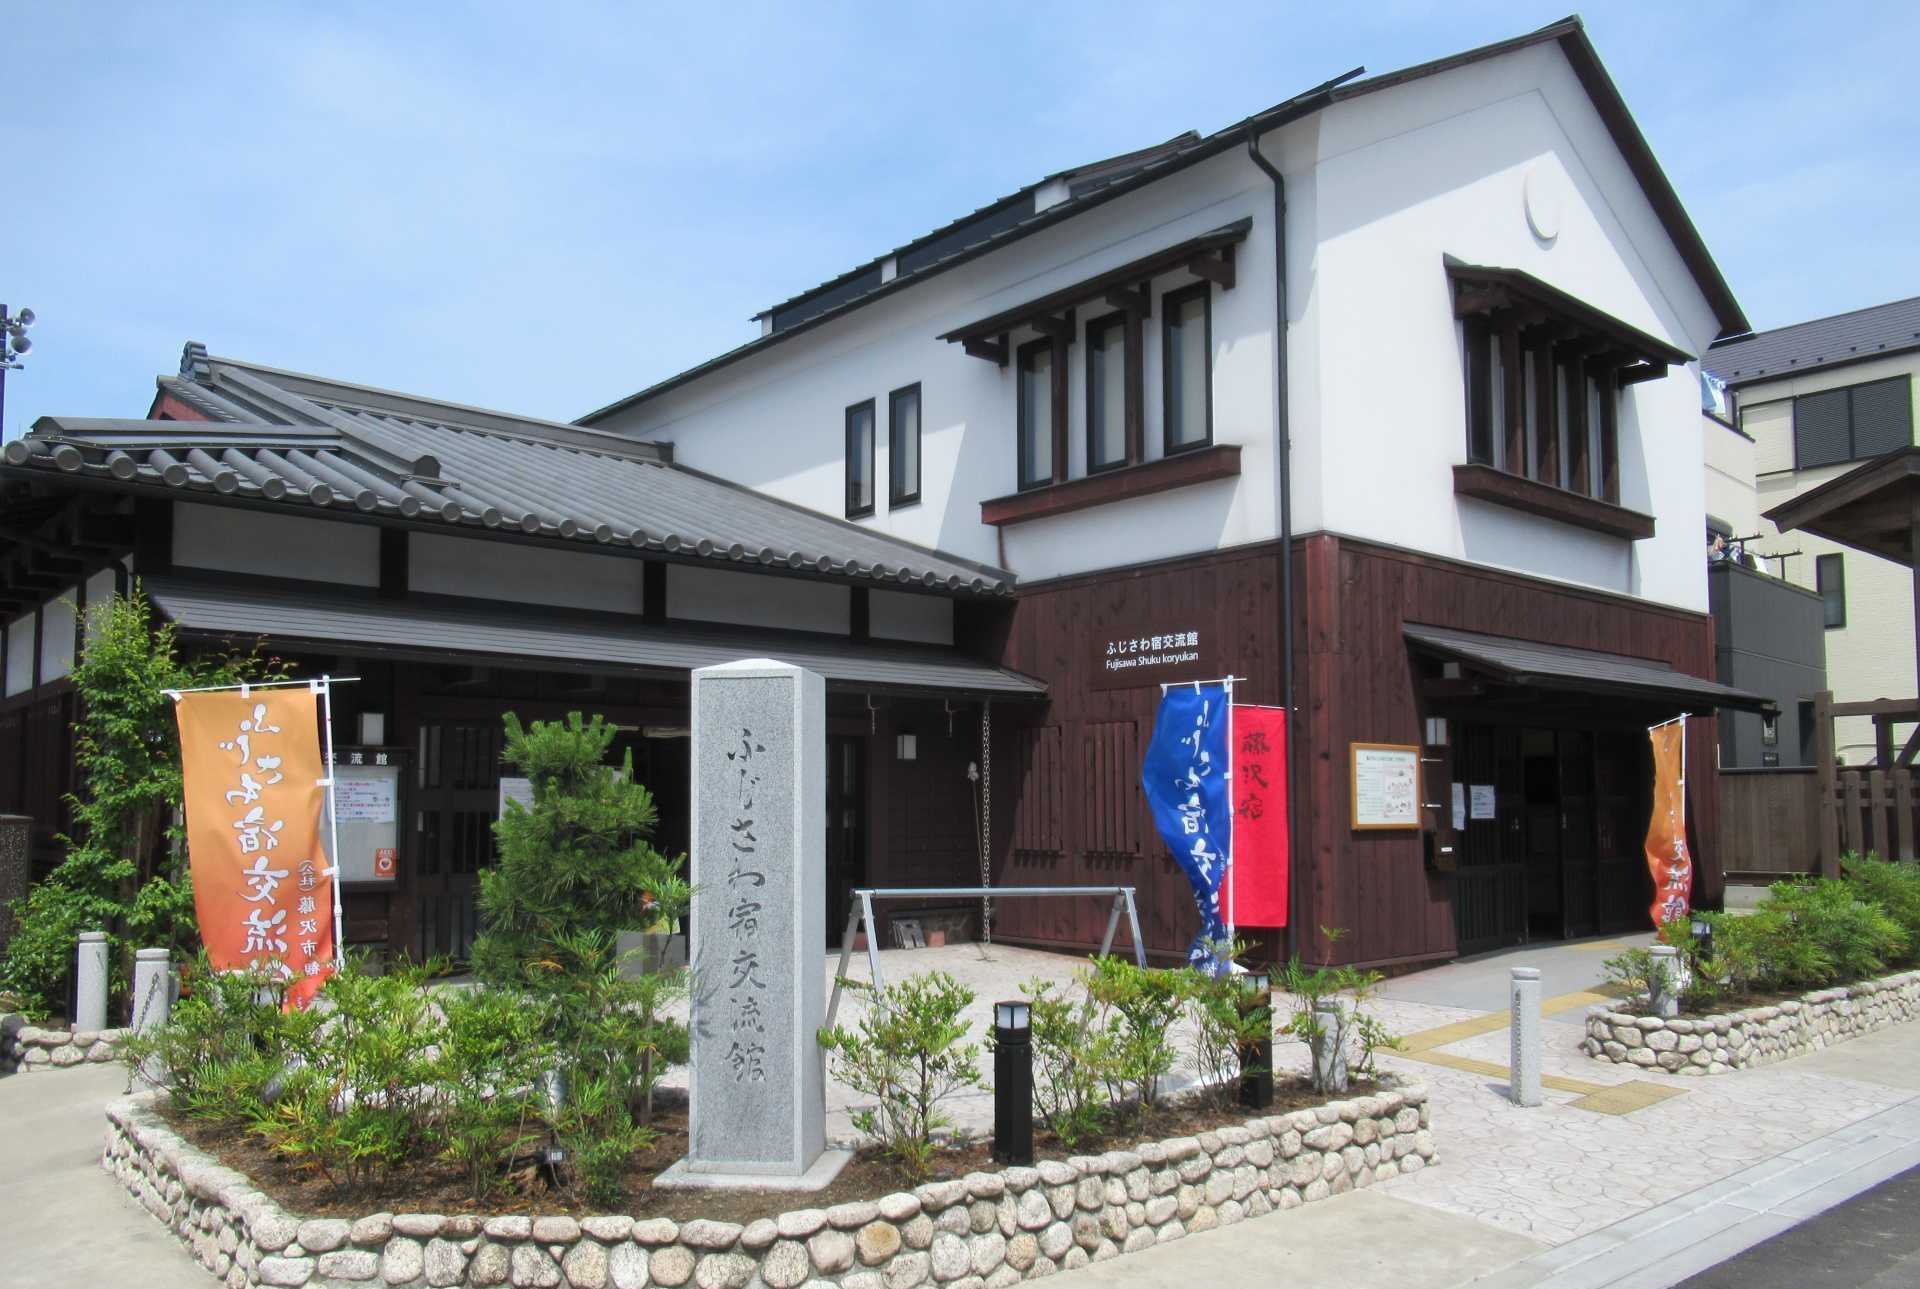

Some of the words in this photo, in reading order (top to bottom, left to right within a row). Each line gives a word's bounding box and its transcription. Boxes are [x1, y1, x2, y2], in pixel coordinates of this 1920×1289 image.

[1106, 631, 1198, 655] ふじさわ宿交流館
[1106, 658, 1137, 671] Fujisawa
[1138, 654, 1161, 666] Shuku
[1162, 651, 1198, 664] koryukan
[725, 727, 767, 1083] ふじさわ宿交流館
